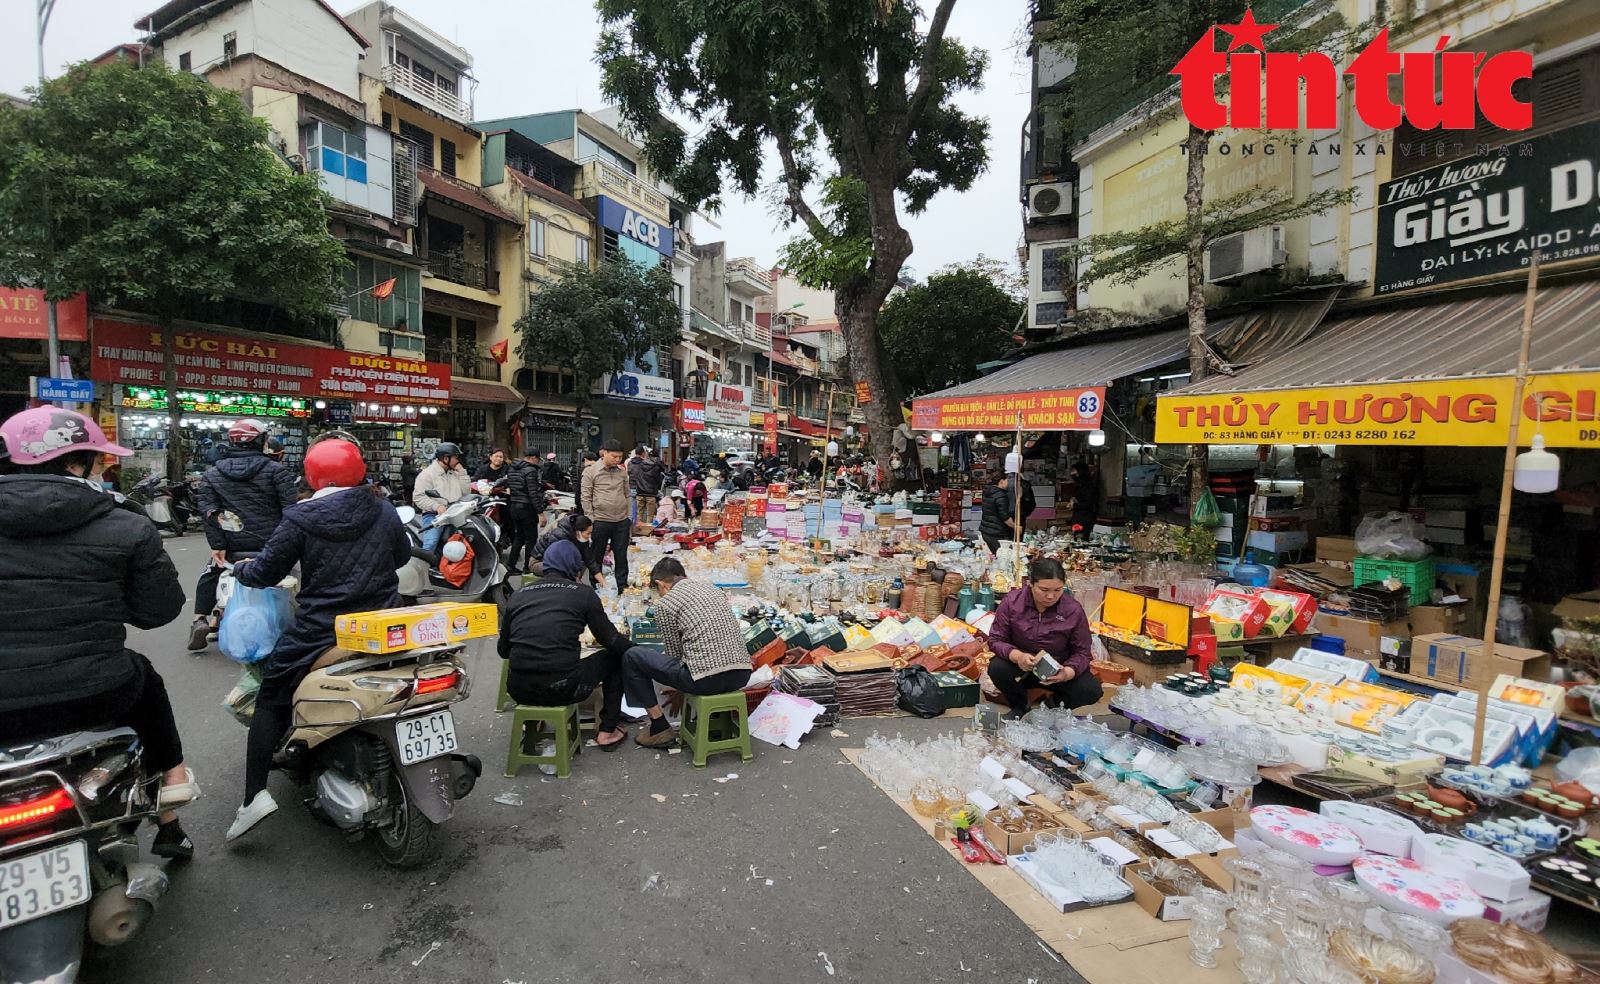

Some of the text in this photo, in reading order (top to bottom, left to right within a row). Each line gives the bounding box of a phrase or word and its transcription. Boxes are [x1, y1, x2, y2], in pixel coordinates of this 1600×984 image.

[1550, 159, 1600, 213] D
[621, 209, 660, 248] ACB
[1421, 254, 1455, 271] ĐẠI
[1497, 229, 1571, 256] KAIDO
[1391, 278, 1414, 290] HÀNG
[98, 346, 120, 360] THAY
[349, 356, 391, 369] ĐỨC
[121, 367, 153, 380] IPHONE
[185, 372, 205, 384] OPPO
[211, 375, 248, 388] SAMSUNG
[253, 378, 271, 389] SONY
[608, 373, 640, 397] ACB
[1079, 396, 1097, 413] 83
[1173, 389, 1600, 427] THỦY HƯƠNG GI
[1028, 411, 1055, 425] KHÁCH
[1057, 412, 1075, 426] SẠN
[1219, 431, 1231, 440] 83
[1233, 429, 1258, 440] HÀNG
[1260, 428, 1283, 440] GIẤY
[1324, 430, 1351, 440] 0243
[1355, 430, 1387, 440] 8280
[1392, 430, 1416, 440] 162
[406, 714, 445, 740] 29-C1
[404, 733, 455, 762] 697.35
